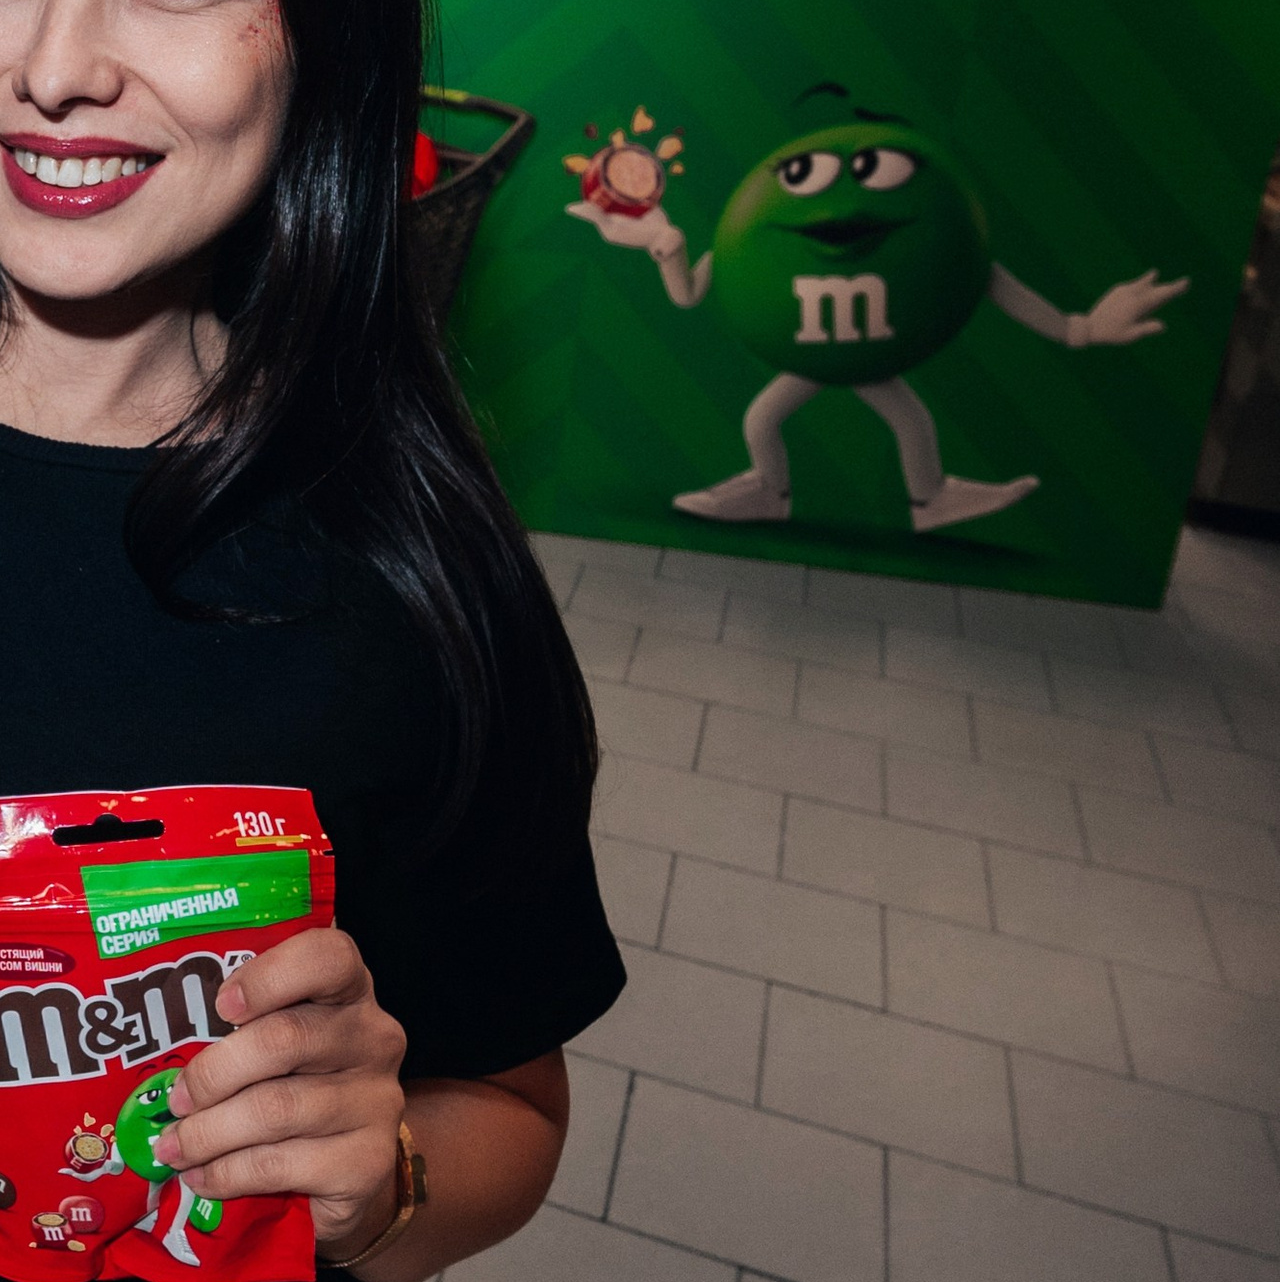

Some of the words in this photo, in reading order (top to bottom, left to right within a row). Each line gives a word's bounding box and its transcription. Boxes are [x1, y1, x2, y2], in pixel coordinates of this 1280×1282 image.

[792, 273, 895, 344] m
[96, 888, 240, 934] ОГРАНИЧЕННАЯ
[100, 927, 160, 955] СЕРИЯ
[25, 961, 63, 974] ВИШНИ
